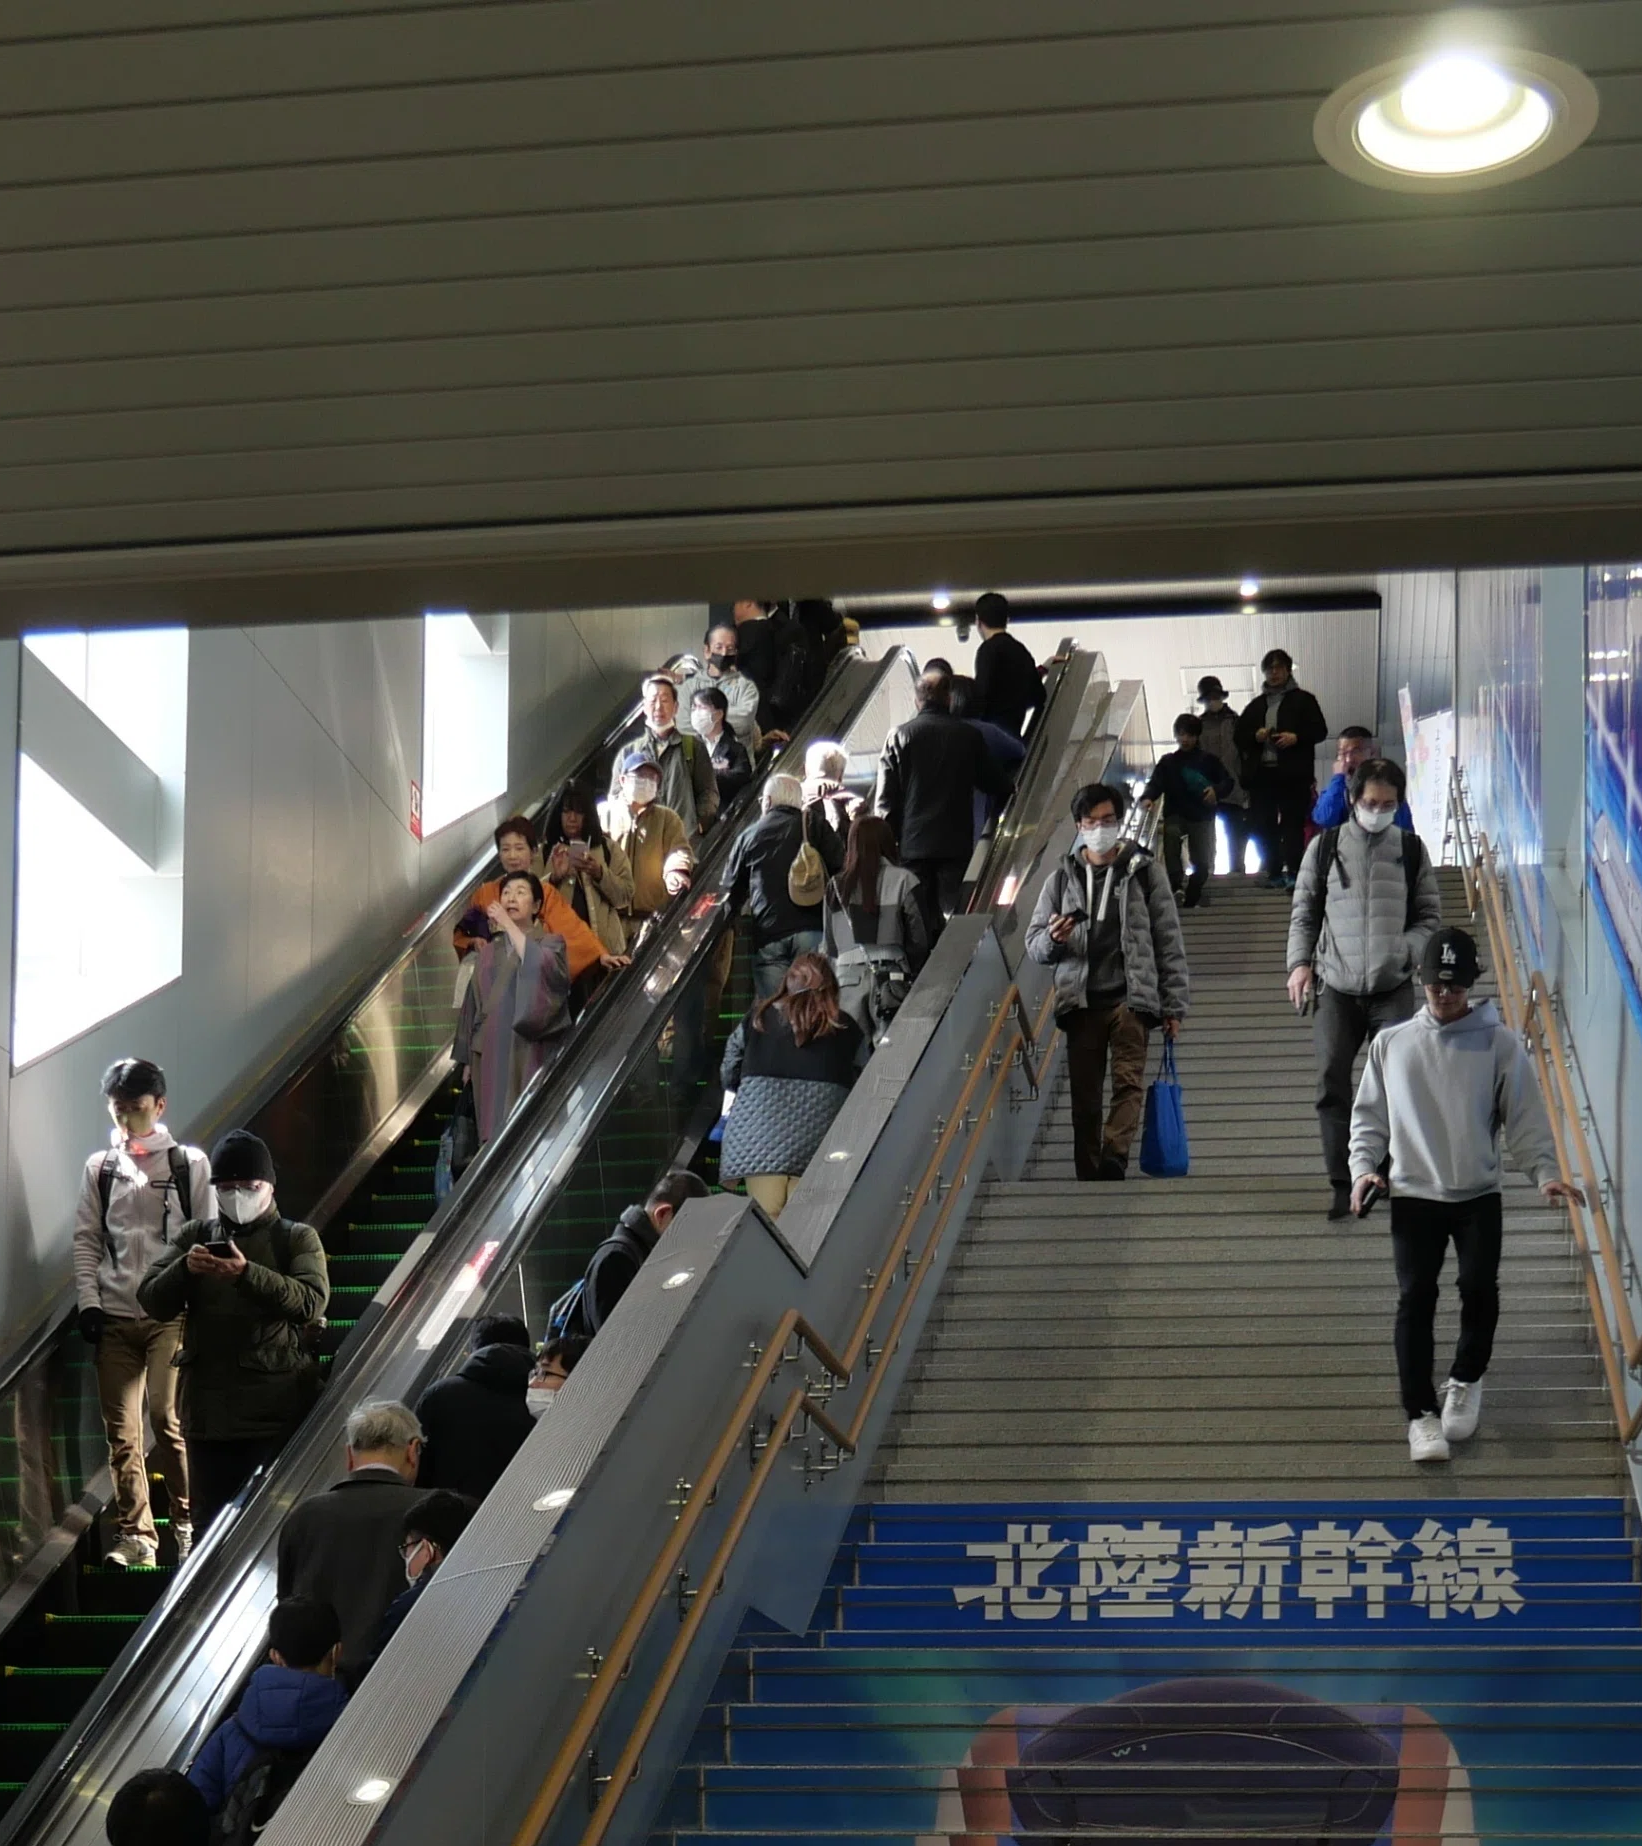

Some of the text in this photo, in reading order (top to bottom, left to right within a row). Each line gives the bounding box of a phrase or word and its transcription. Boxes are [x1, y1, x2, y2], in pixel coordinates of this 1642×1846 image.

[953, 1517, 1525, 1621] 北陸新幹線
